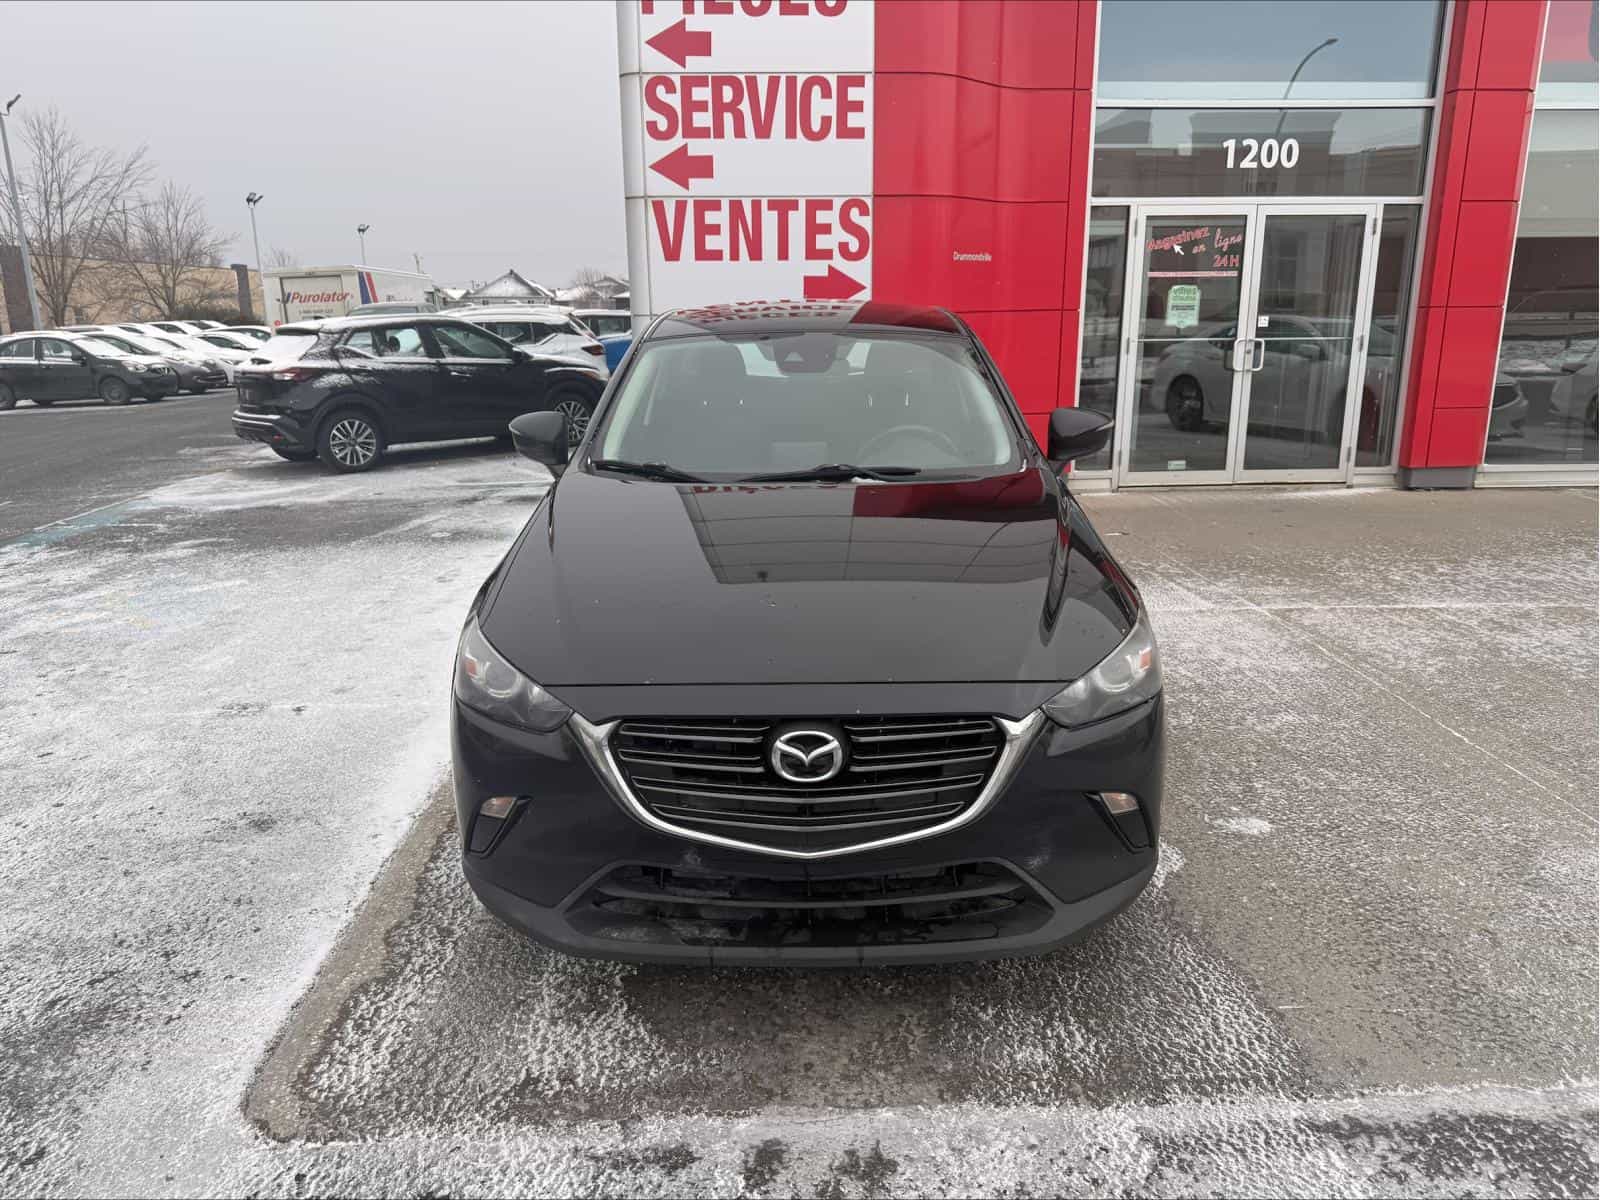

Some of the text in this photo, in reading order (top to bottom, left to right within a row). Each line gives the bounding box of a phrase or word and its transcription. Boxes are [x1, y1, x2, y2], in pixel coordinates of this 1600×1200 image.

[644, 74, 866, 142] SERVICE
[1222, 138, 1300, 169] 1200
[651, 198, 870, 263] VENTES
[1214, 227, 1242, 251] ligne
[290, 291, 350, 304] Purolator
